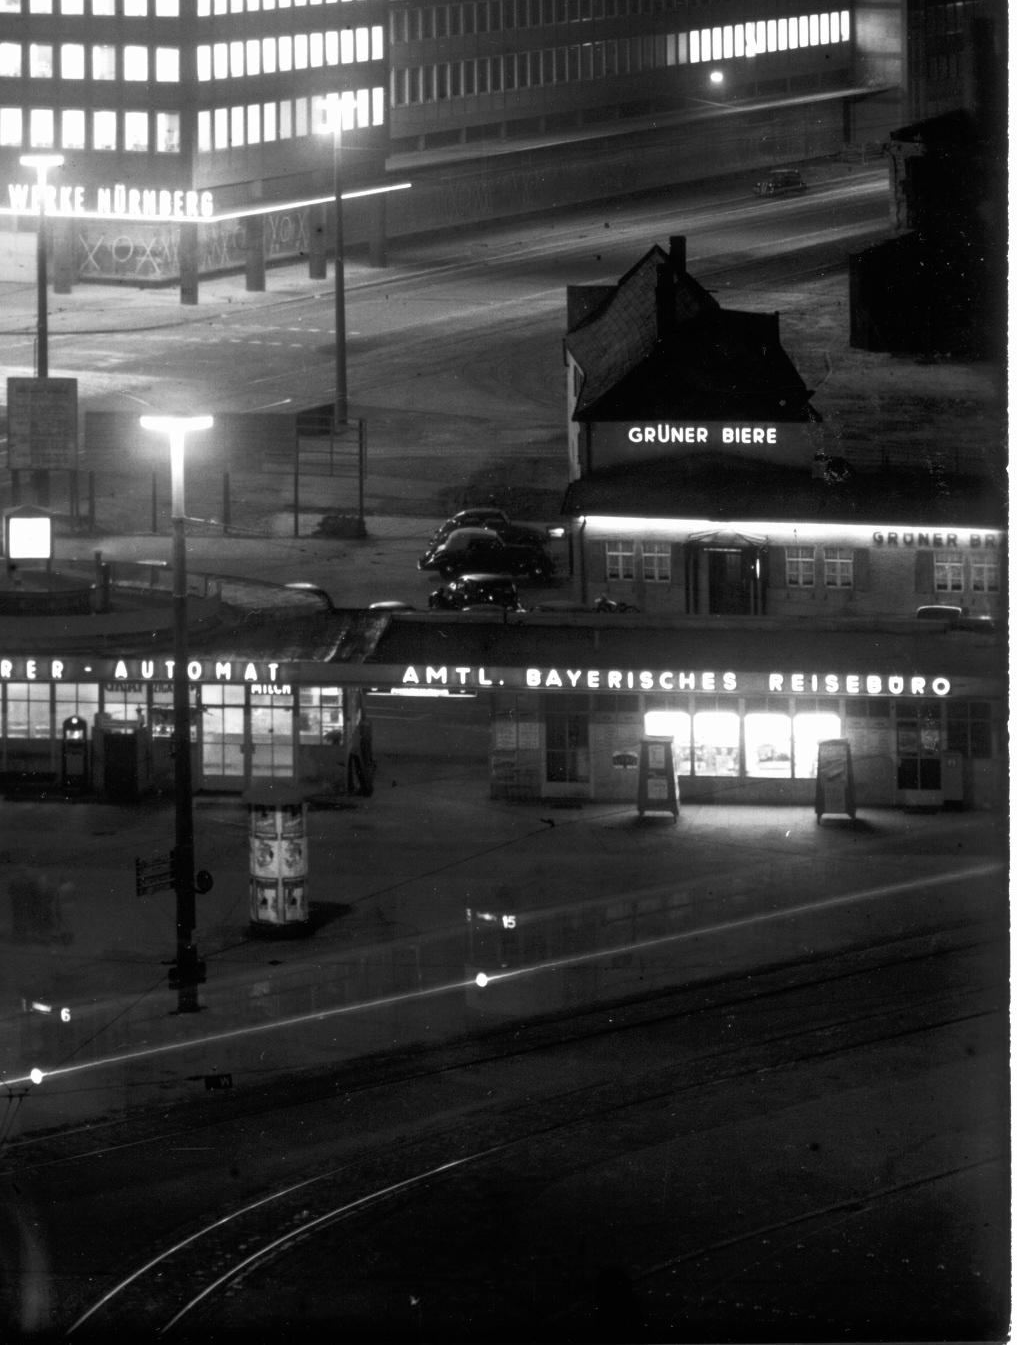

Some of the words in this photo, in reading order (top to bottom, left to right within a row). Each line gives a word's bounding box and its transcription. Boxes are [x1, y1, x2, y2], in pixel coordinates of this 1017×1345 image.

[8, 183, 85, 214] WERKE
[97, 183, 214, 217] NÜRNBERG
[628, 423, 708, 443] GRÜNER
[722, 427, 777, 444] BIERE
[115, 660, 279, 682] AUTOMAT
[402, 665, 505, 687] AMTL.
[526, 668, 737, 694] BAYERISCHES
[769, 673, 951, 696] REISEBÜRO
[502, 915, 516, 929] 15
[60, 1007, 71, 1022] 6
